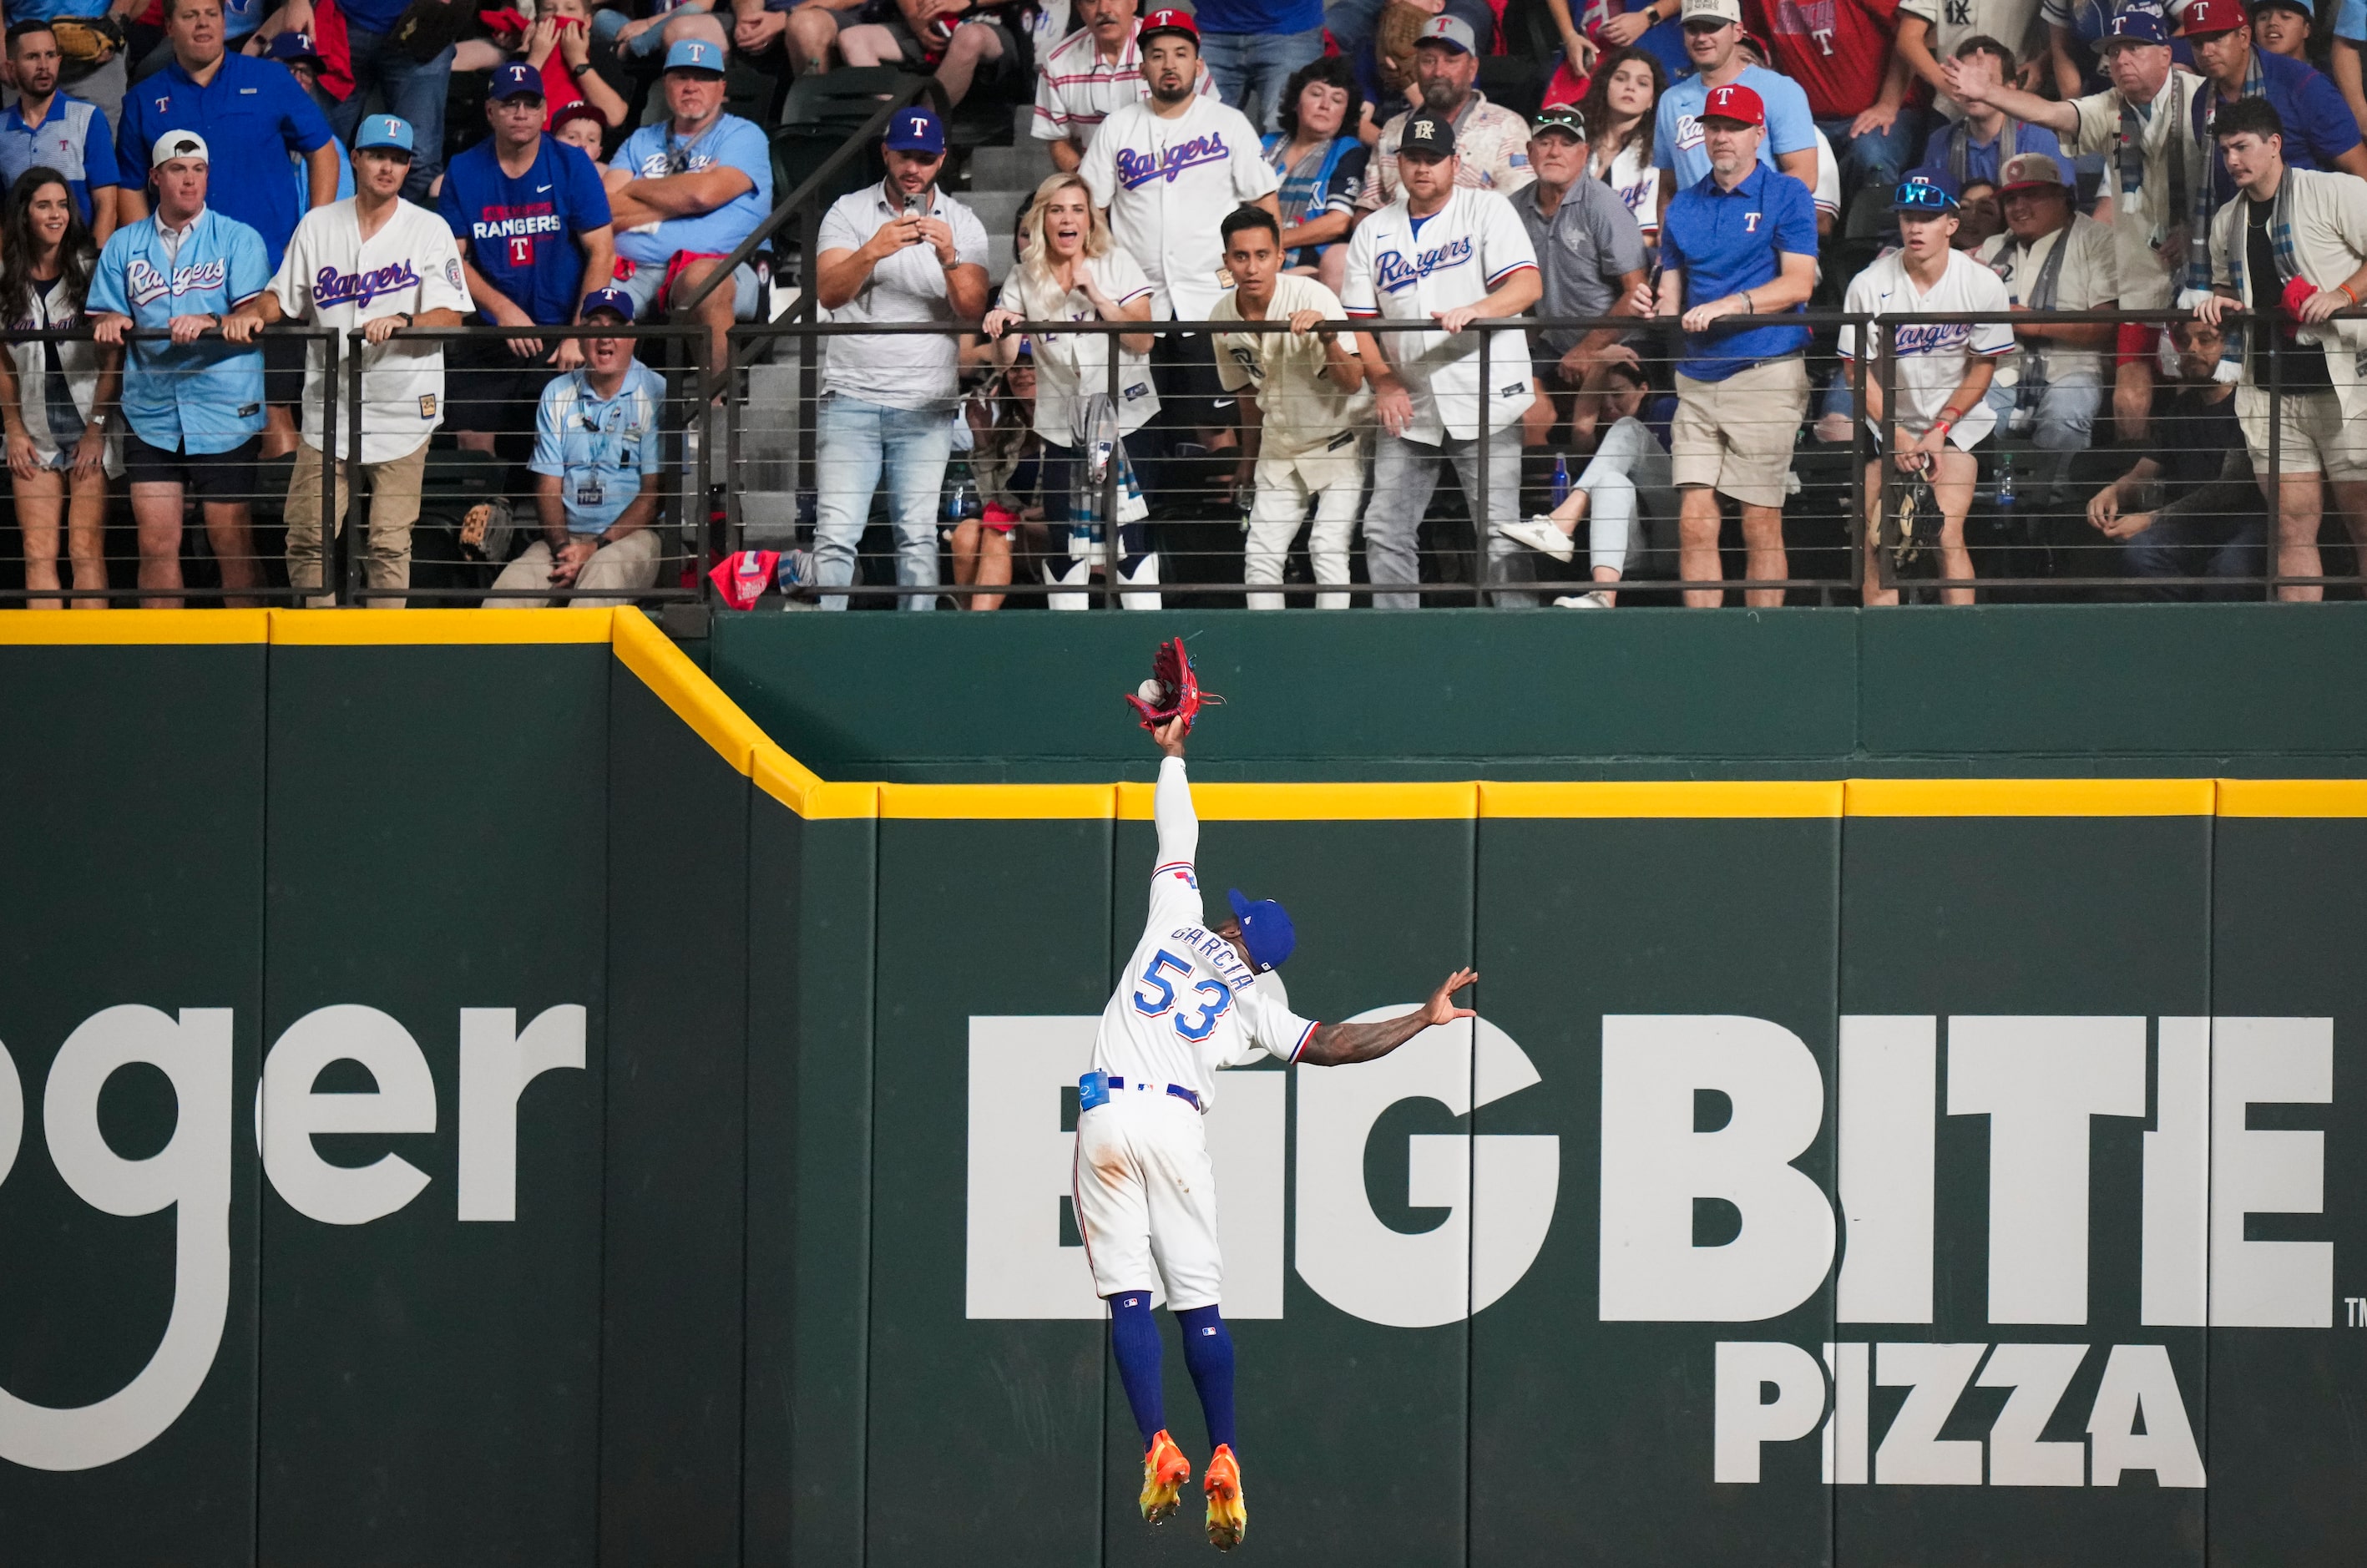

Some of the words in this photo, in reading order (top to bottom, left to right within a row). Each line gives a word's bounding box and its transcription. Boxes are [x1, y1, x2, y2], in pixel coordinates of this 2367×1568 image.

[1156, 10, 1173, 26] T
[2193, 2, 2209, 22] T
[1436, 17, 1453, 33] T
[2112, 16, 2127, 35] T
[297, 33, 313, 50] T
[1813, 28, 1833, 56] T
[688, 43, 705, 63] T
[509, 66, 527, 82] T
[155, 95, 170, 114] T
[1717, 88, 1734, 105] T
[385, 119, 402, 138] T
[910, 117, 928, 138] T
[58, 139, 68, 151] T
[1116, 131, 1229, 191] Rangers
[473, 215, 561, 240] RANGERS
[1744, 212, 1761, 233] T
[510, 238, 529, 260] T
[1375, 234, 1474, 294] Rangers
[127, 256, 225, 306] Rangers
[313, 258, 420, 310] Rangers
[602, 288, 618, 301] T
[1132, 949, 1234, 1043] 53
[1599, 1014, 2334, 1328] BITE
[0, 1004, 587, 1471] ger
[1714, 1341, 2207, 1488] PIZZA
